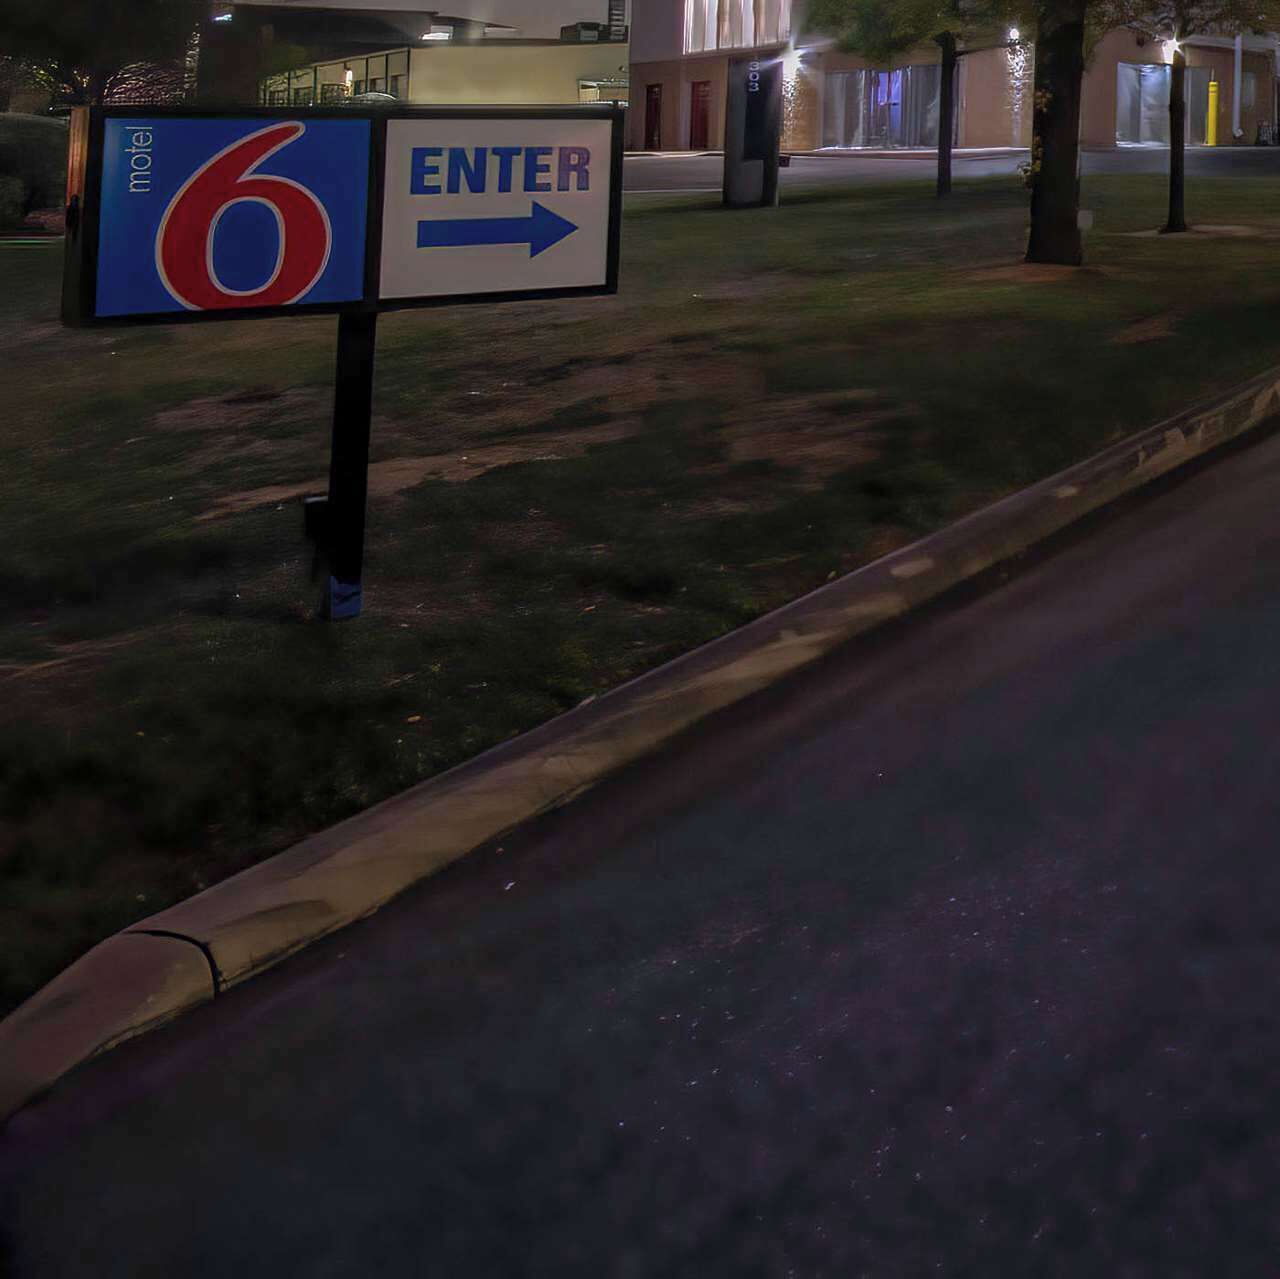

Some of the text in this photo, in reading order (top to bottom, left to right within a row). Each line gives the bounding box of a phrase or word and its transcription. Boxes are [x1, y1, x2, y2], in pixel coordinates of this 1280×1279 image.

[125, 126, 152, 193] motel
[410, 146, 591, 195] ENTER
[155, 121, 332, 309] 6
